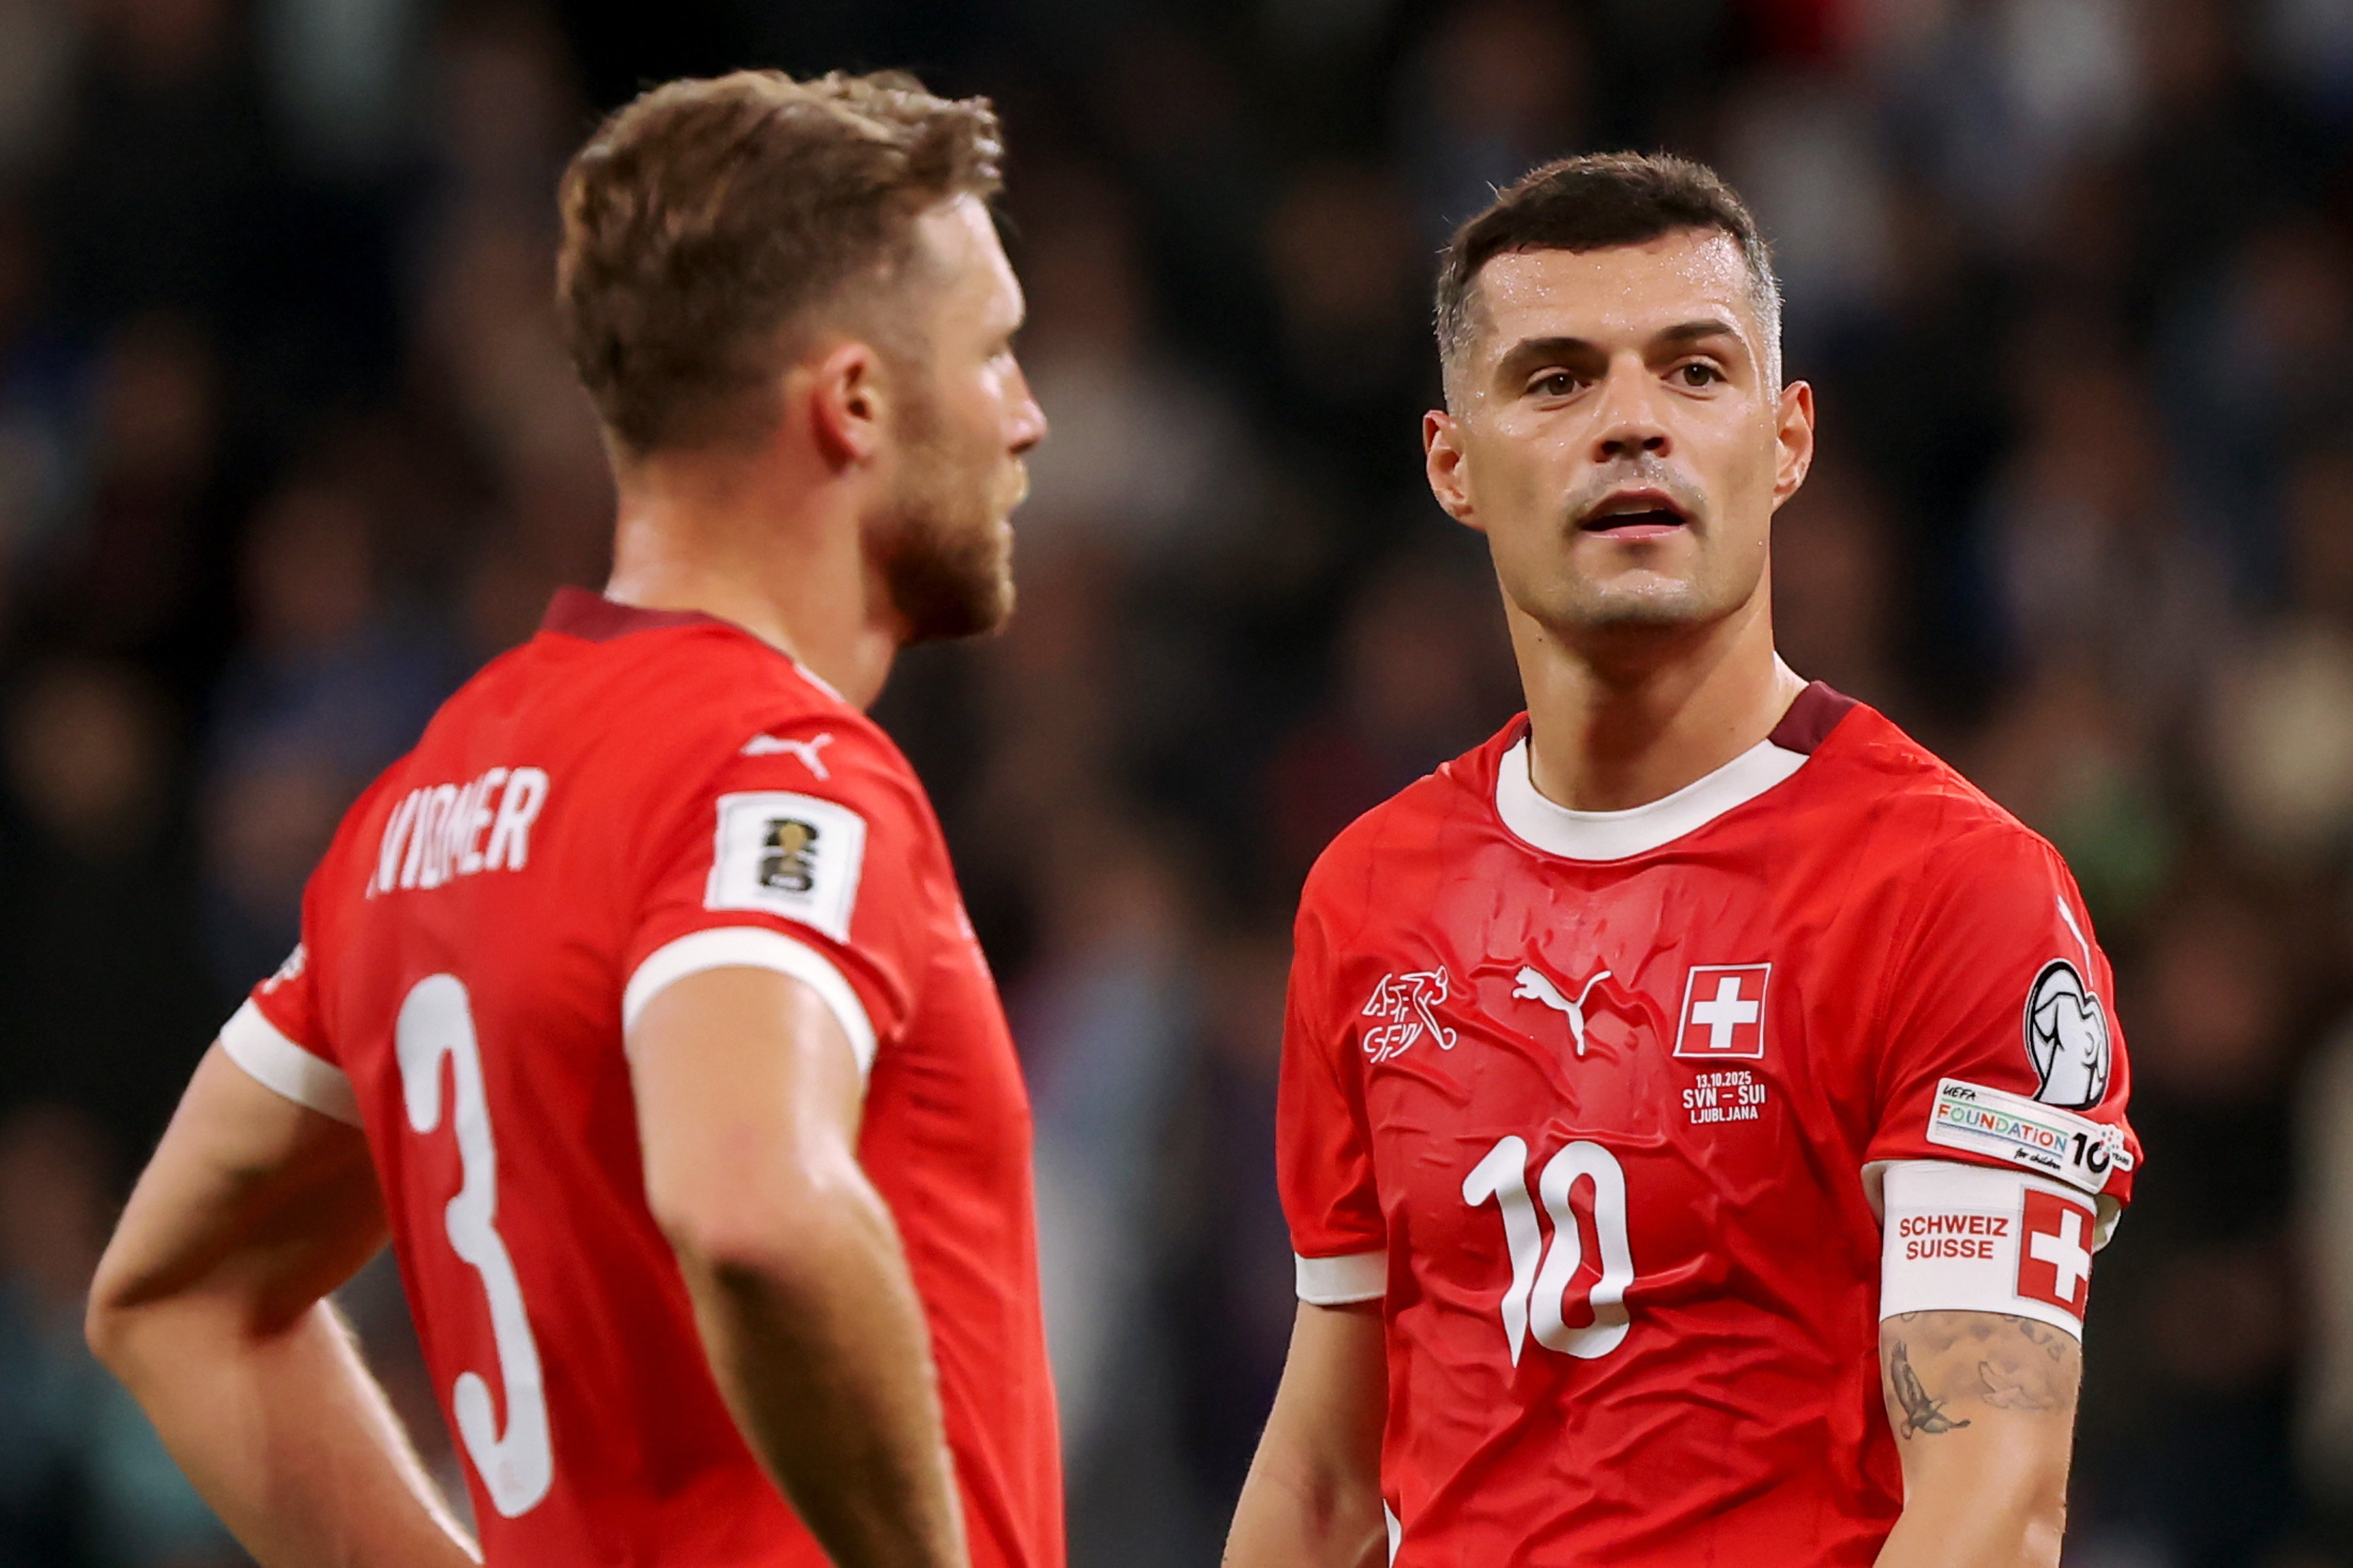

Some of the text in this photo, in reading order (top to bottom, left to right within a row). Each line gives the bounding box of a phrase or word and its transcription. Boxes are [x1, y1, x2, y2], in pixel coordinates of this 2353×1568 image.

[1696, 1071, 1752, 1088] 13.10.2025
[1683, 1088, 1717, 1109] SVN
[1738, 1083, 1766, 1105] SUI
[1943, 1084, 1976, 1101] UEFA
[1690, 1105, 1758, 1124] LJUBLJANA
[1937, 1103, 2067, 1154] FOUNDATION
[2014, 1147, 2061, 1171] for children
[2073, 1132, 2110, 1174] 10
[1900, 1215, 2008, 1237] SCHWEIZ
[396, 974, 554, 1517] 3
[1462, 1135, 1634, 1367] 10
[1906, 1238, 1994, 1260] SUISSE
